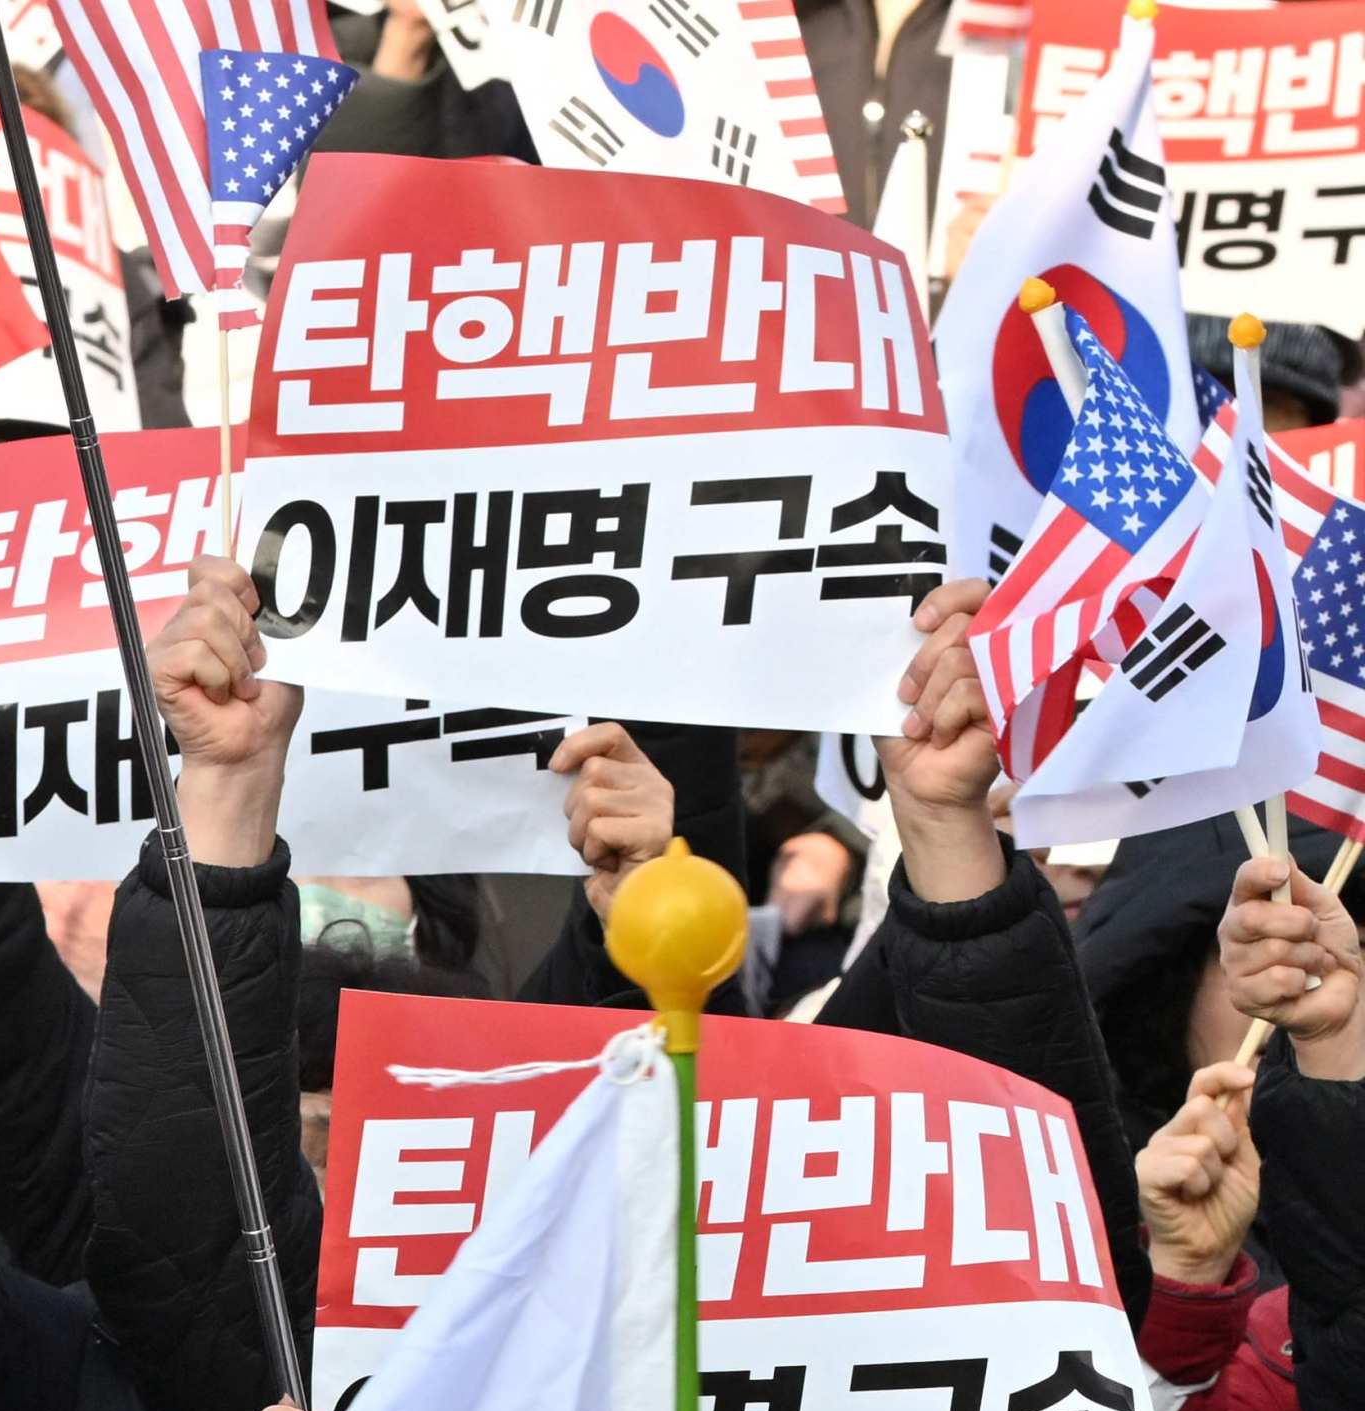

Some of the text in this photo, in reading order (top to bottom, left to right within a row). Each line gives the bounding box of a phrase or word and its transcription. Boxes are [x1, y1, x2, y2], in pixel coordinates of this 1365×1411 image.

[272, 236, 925, 436] 탄핵반대
[250, 470, 948, 643] 이재명 구속
